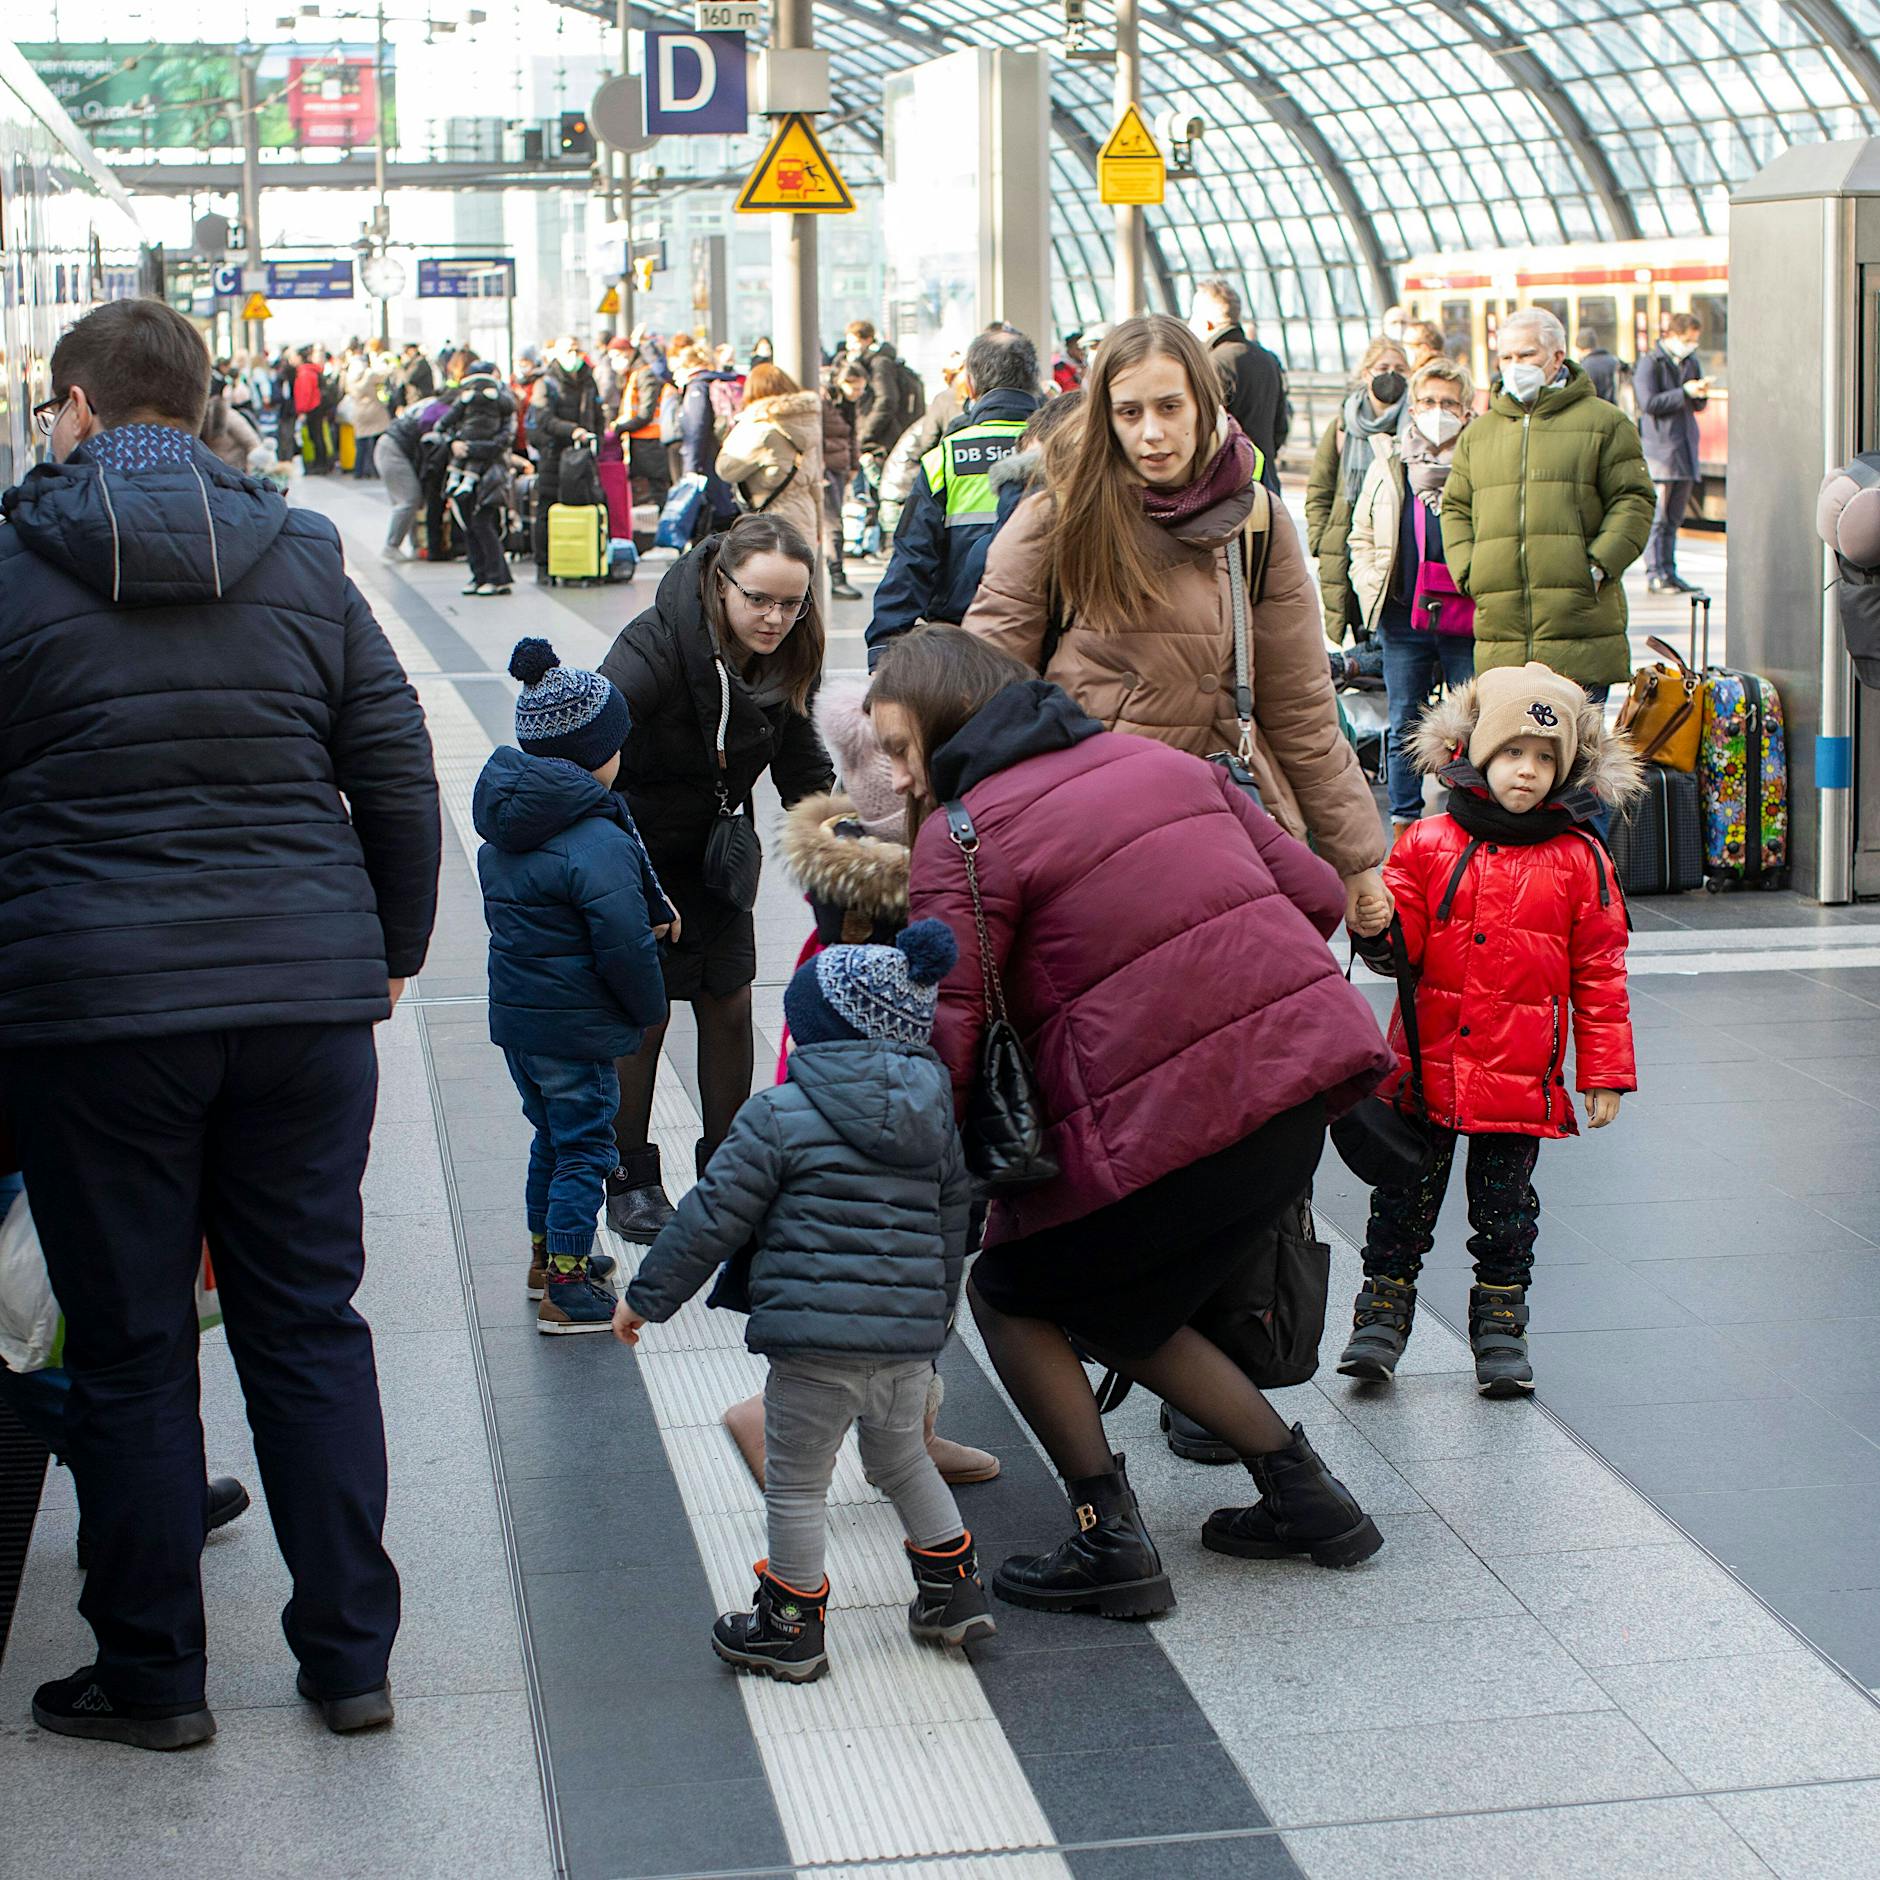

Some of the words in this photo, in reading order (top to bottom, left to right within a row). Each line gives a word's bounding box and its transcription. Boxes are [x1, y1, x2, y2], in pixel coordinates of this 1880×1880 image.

[703, 8, 731, 25] 160
[738, 12, 756, 25] m
[658, 35, 717, 112] D
[216, 267, 235, 292] C
[954, 447, 982, 463] DB
